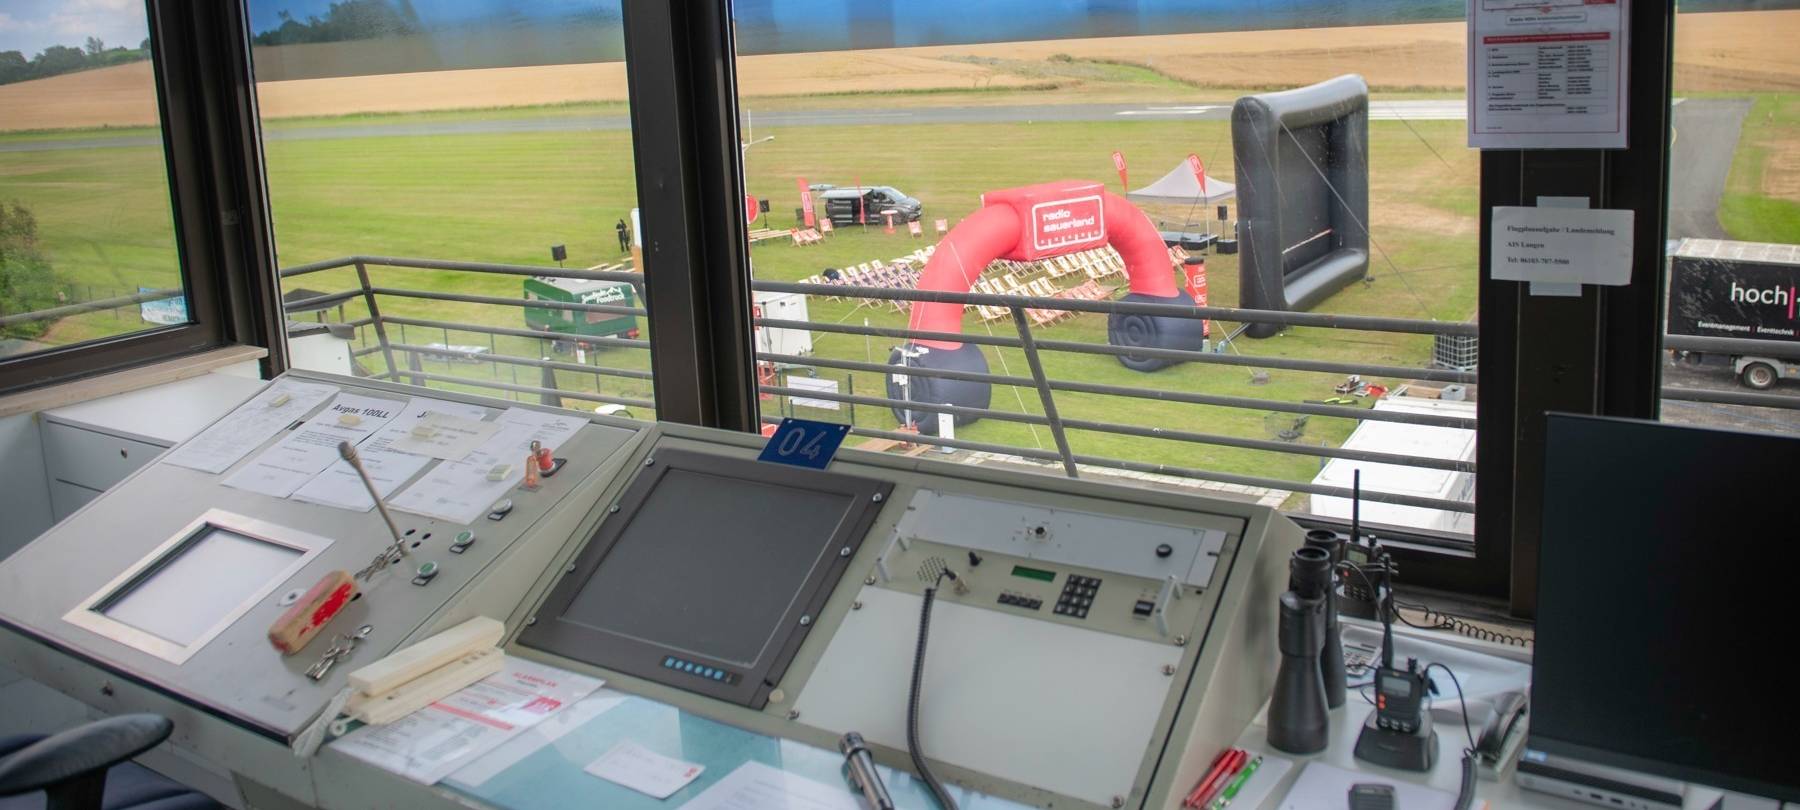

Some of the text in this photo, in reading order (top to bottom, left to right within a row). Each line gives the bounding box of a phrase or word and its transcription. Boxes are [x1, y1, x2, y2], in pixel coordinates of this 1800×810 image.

[1043, 209, 1071, 221] radio
[1043, 215, 1095, 232] sauerland
[1730, 281, 1789, 306] hoch
[332, 403, 390, 419] Avgas 100LL
[778, 426, 827, 460] 04
